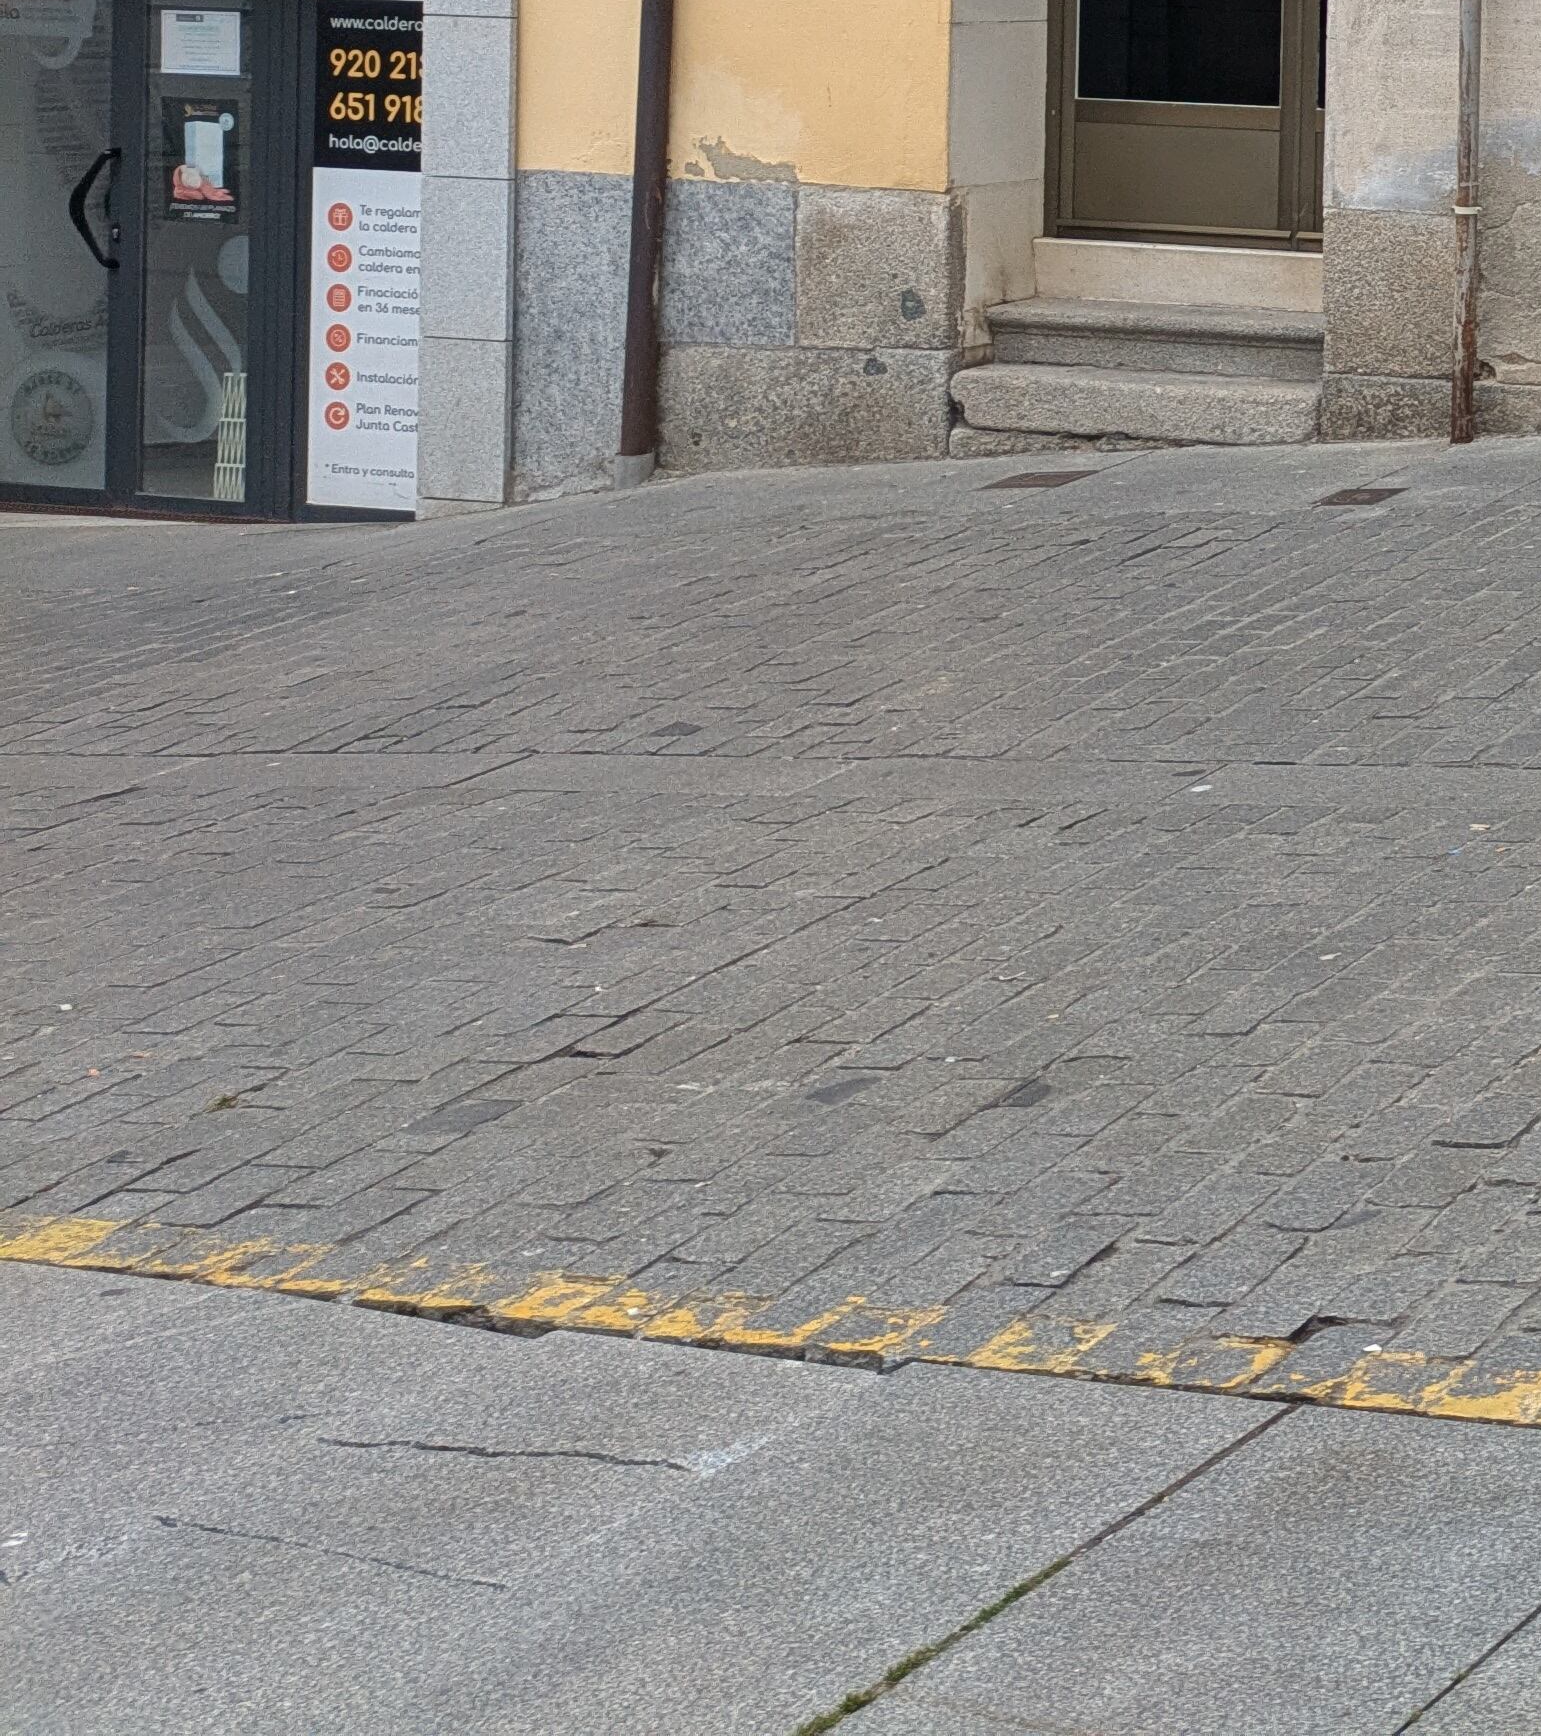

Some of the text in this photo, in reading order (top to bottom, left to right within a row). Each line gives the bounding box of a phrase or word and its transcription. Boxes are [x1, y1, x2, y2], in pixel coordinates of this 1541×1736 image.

[330, 48, 382, 79] 920
[330, 92, 376, 121] 651
[360, 204, 373, 216] Te
[359, 221, 417, 234] la caldera
[358, 263, 403, 274] caldera
[358, 303, 372, 313] en
[375, 303, 389, 314] 36
[356, 402, 381, 415] Plan
[356, 419, 390, 431] Junta
[362, 467, 369, 477] y
